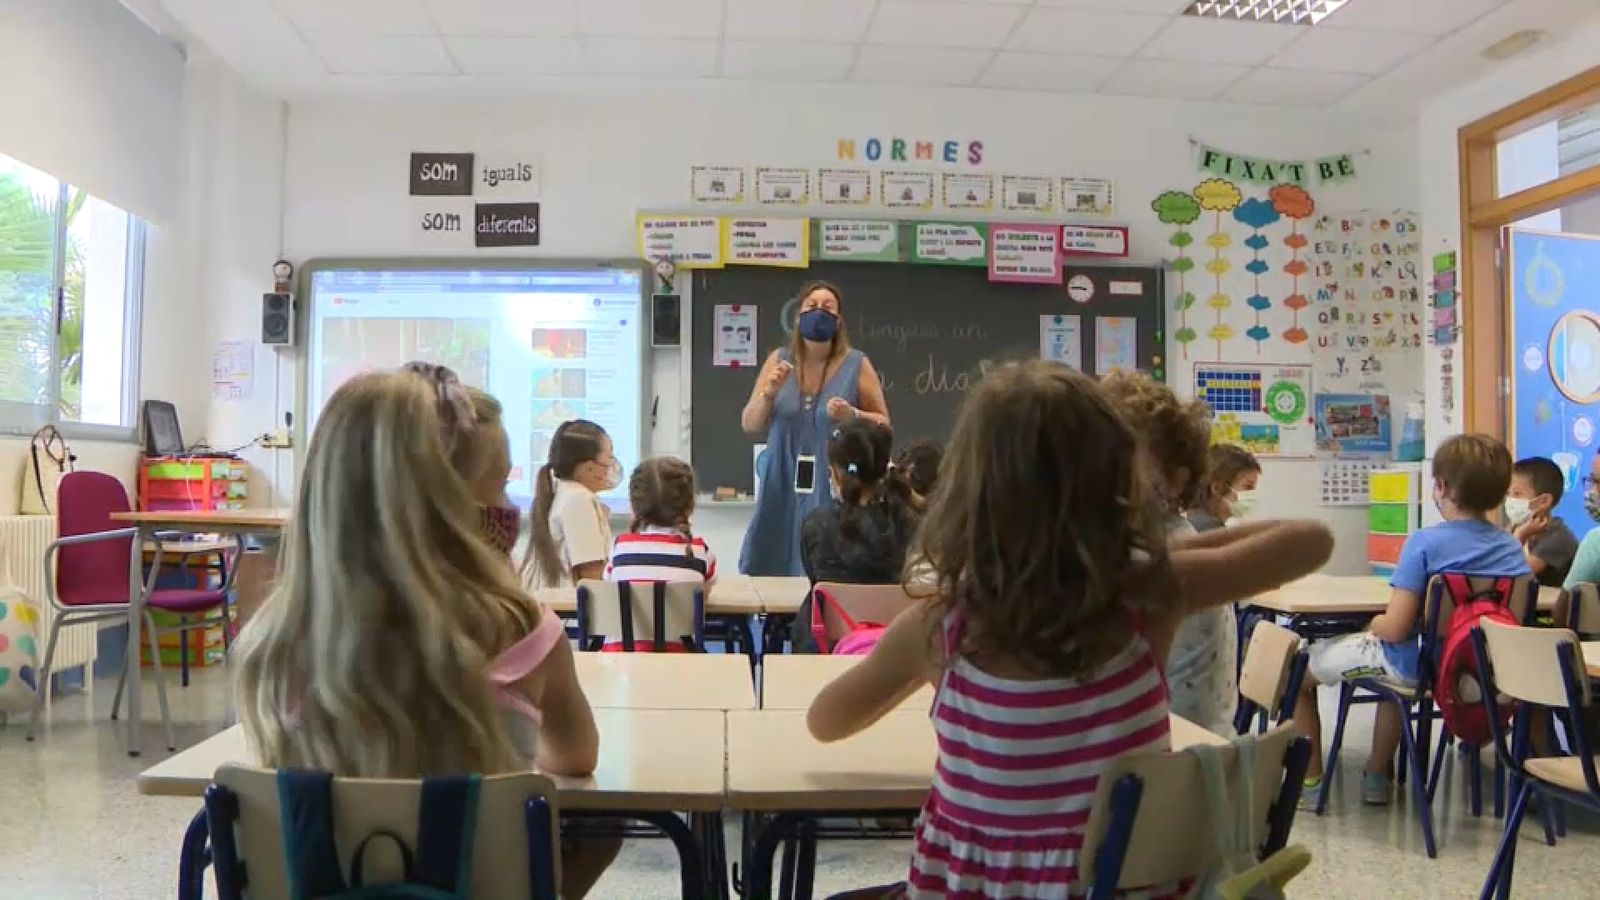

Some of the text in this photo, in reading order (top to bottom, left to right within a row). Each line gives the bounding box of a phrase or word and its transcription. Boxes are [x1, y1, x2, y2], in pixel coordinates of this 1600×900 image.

[837, 137, 984, 165] NORMES
[419, 162, 533, 187] som iguals
[1202, 150, 1355, 181] FIXA'T BÉ
[421, 212, 537, 234] som diferents
